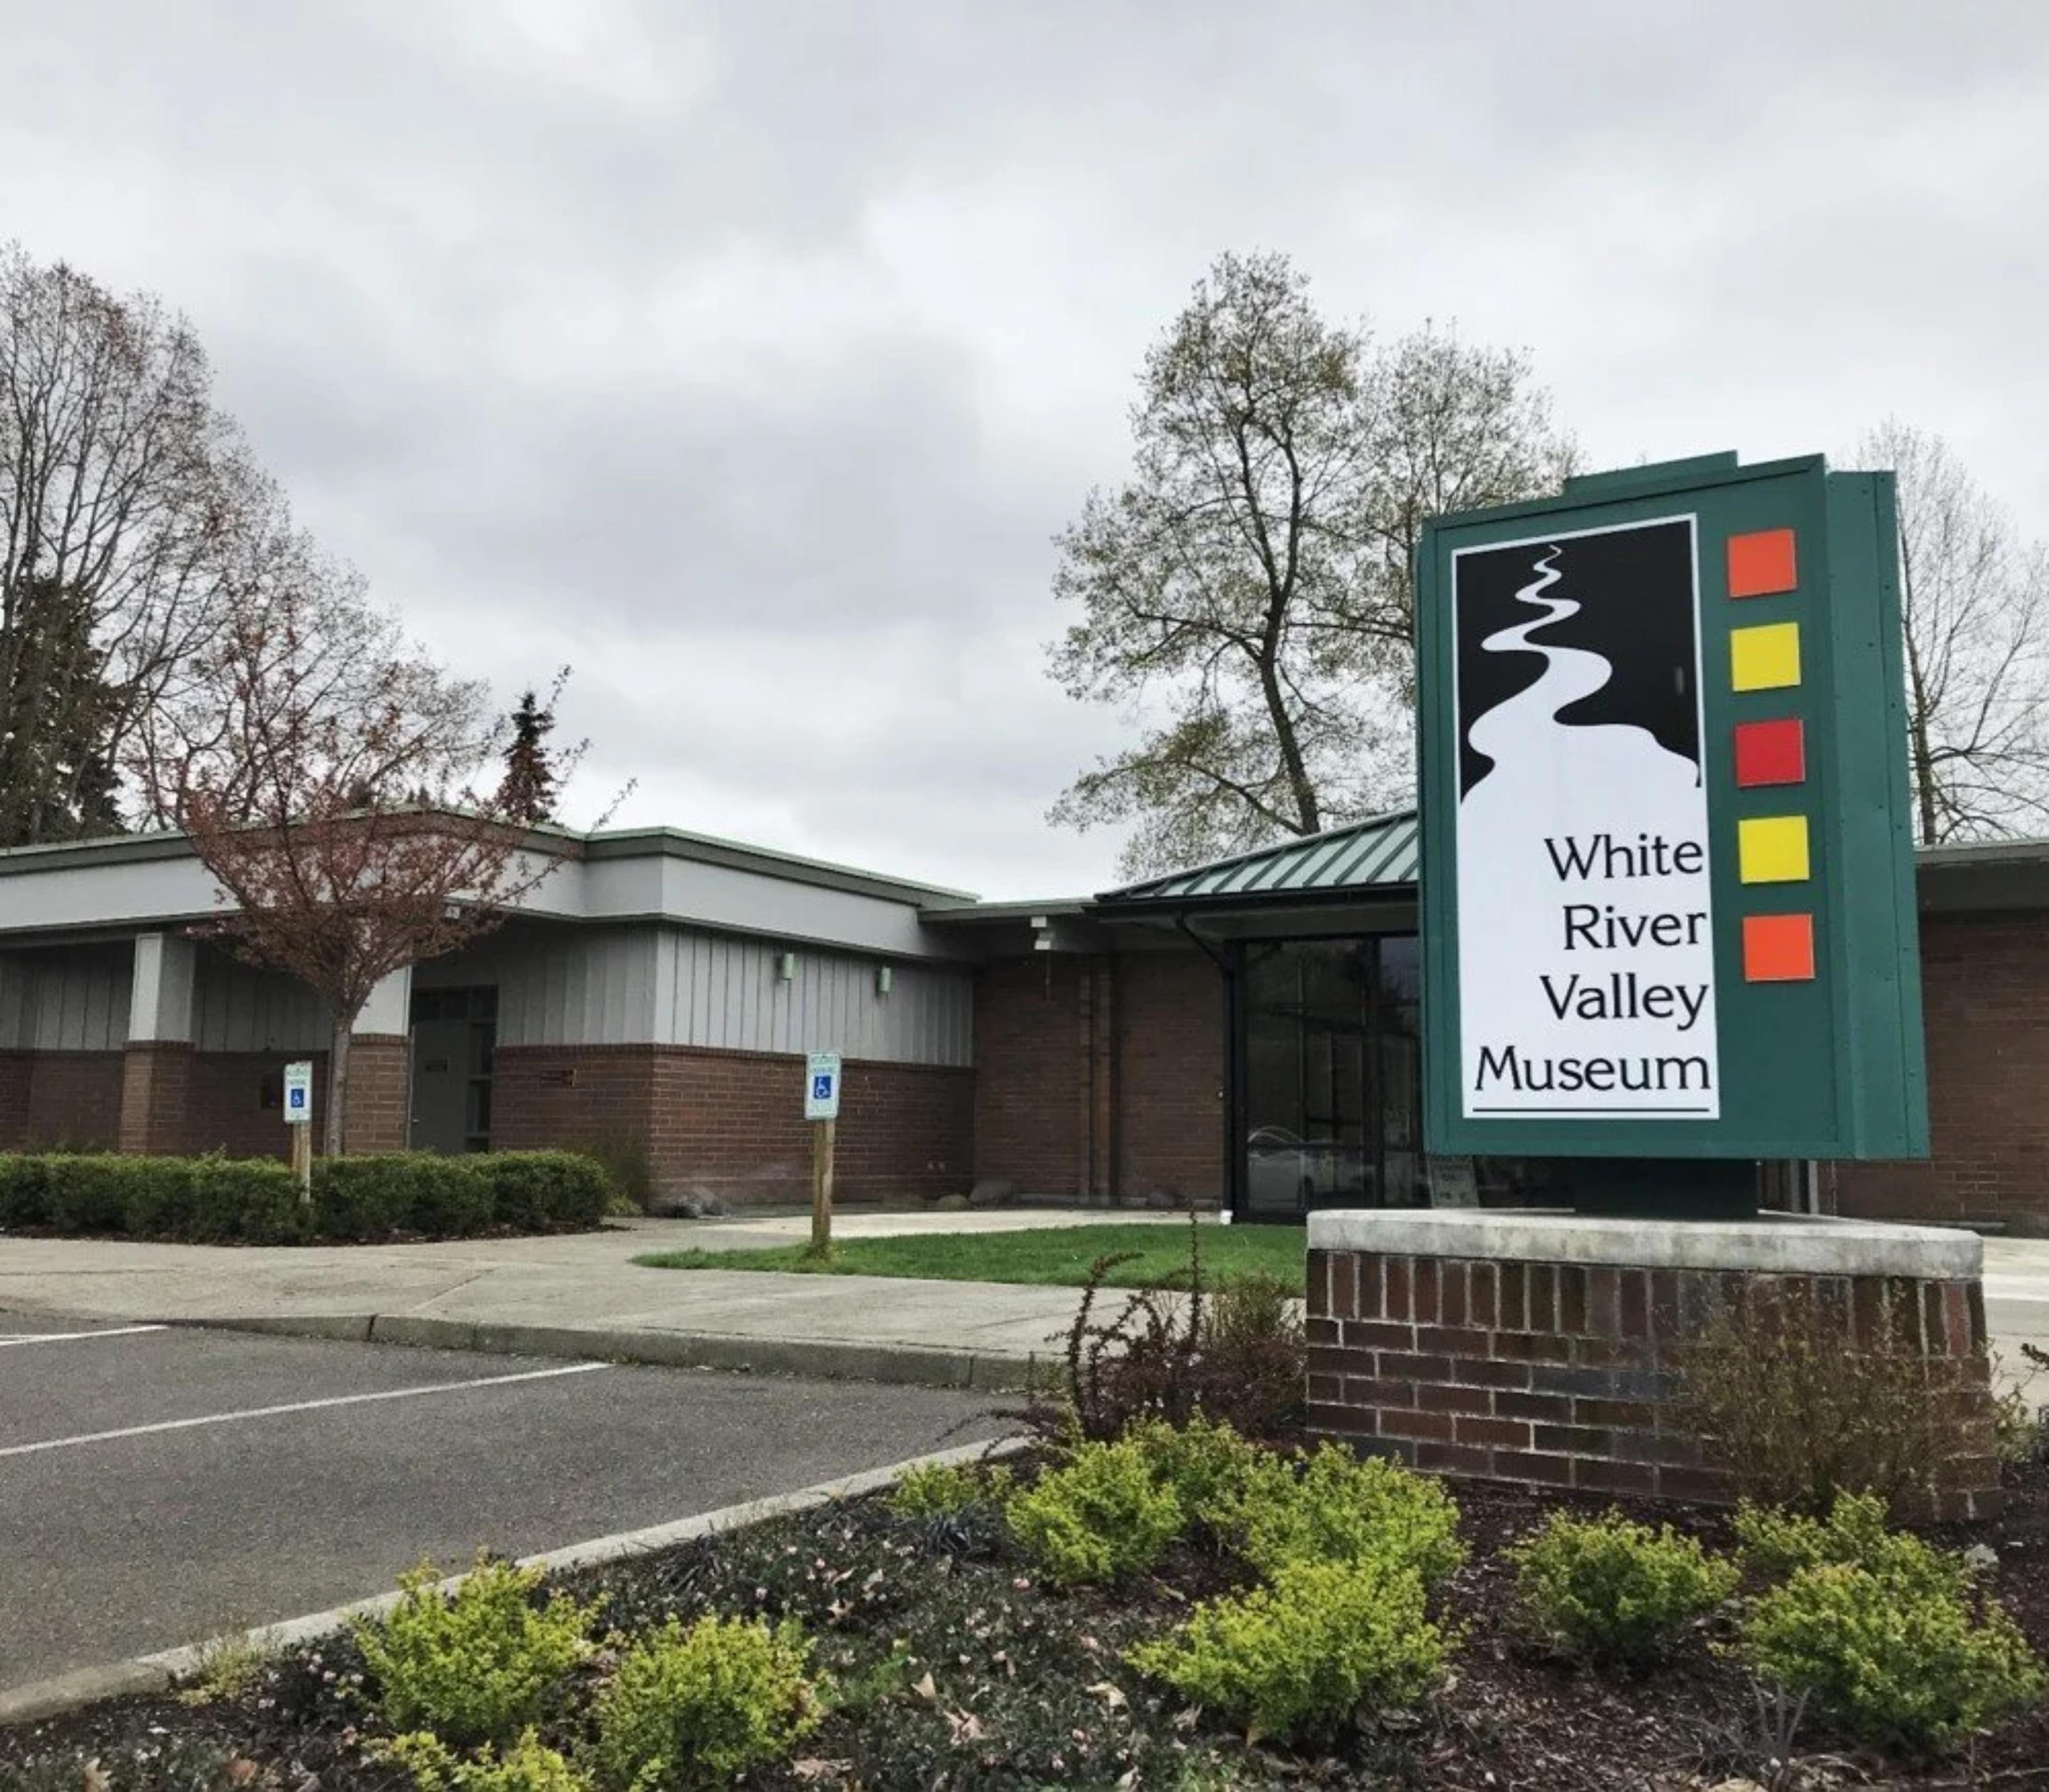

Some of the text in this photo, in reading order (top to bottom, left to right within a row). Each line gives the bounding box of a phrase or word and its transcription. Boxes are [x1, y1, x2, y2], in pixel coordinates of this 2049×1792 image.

[1544, 833, 1703, 882] White
[1562, 903, 1708, 950] River
[1539, 972, 1710, 1032] Valley
[1474, 1045, 1712, 1092] Museum
